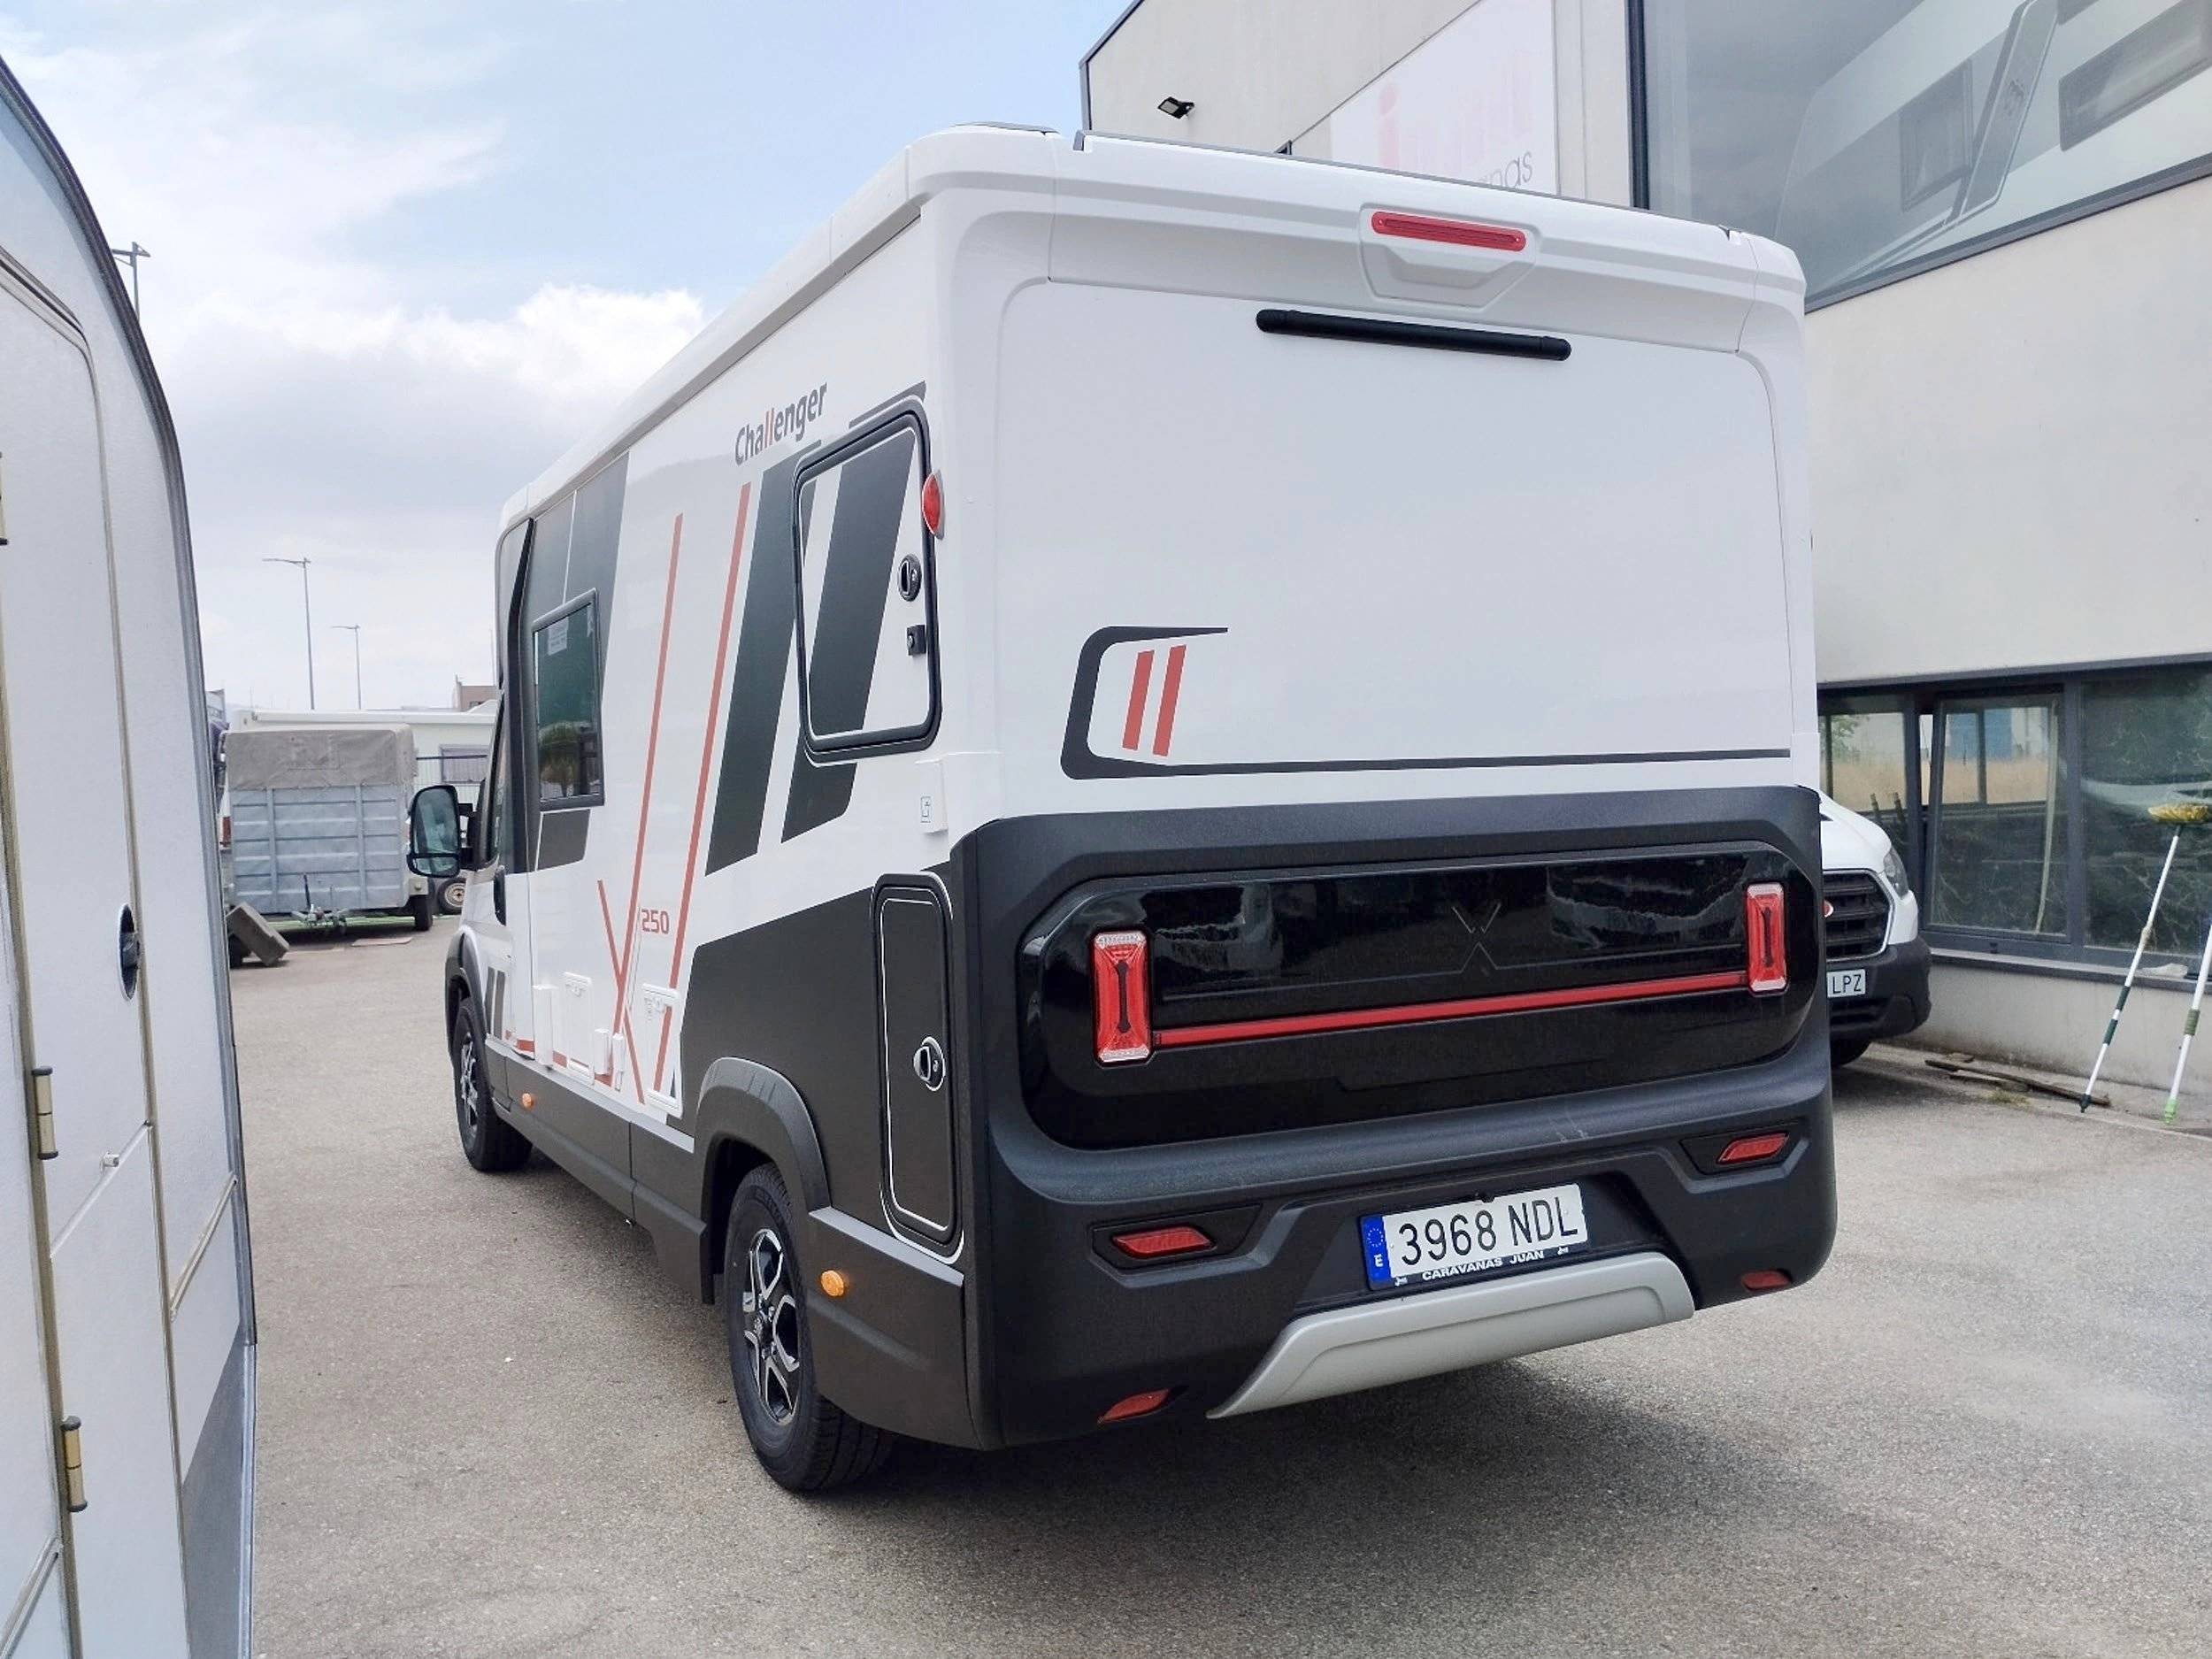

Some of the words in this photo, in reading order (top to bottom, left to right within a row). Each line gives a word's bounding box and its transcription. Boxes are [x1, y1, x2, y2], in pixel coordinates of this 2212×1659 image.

[734, 381, 828, 466] Challenger
[641, 908, 670, 934] 250
[1832, 973, 1863, 995] LPZ
[1398, 1209, 1498, 1266] 3968
[1508, 1196, 1578, 1247] NDL
[1373, 1253, 1384, 1268] E
[1421, 1256, 1504, 1281] CARAVANAS
[1509, 1249, 1545, 1265] JUAN
